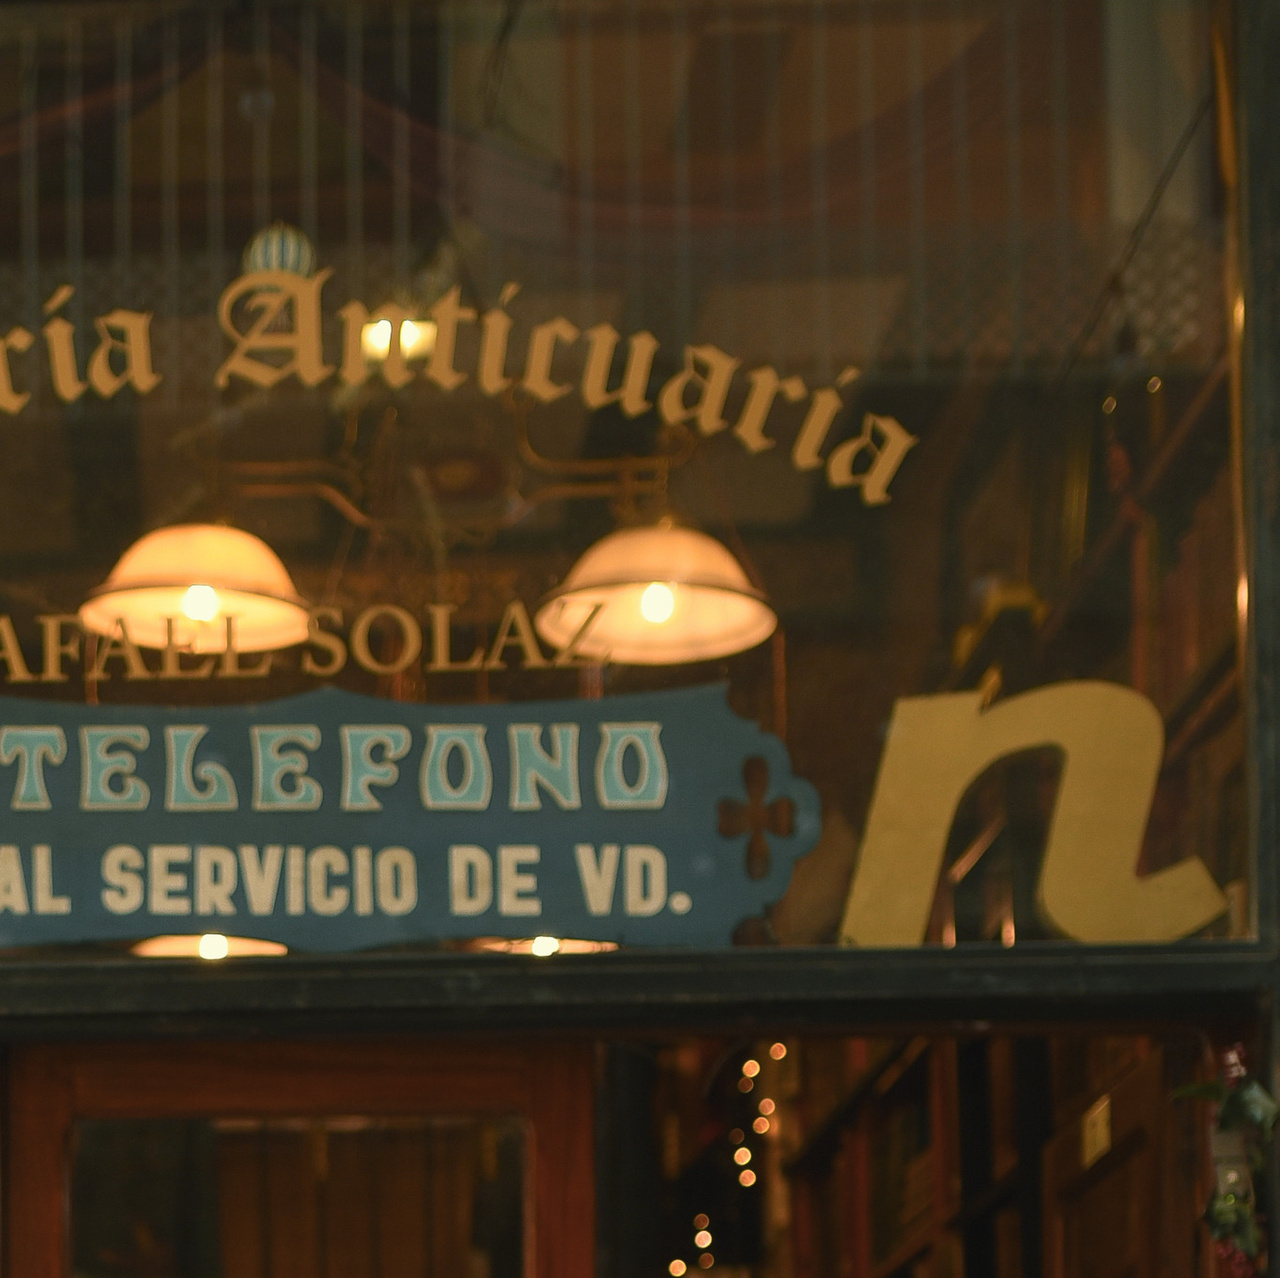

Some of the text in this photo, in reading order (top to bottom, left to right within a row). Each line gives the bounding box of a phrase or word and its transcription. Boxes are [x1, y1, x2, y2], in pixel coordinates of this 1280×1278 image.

[300, 599, 613, 678] SOLAZ
[100, 844, 421, 916] SERVICIO
[448, 844, 543, 916] DE
[573, 844, 694, 916] VD.
